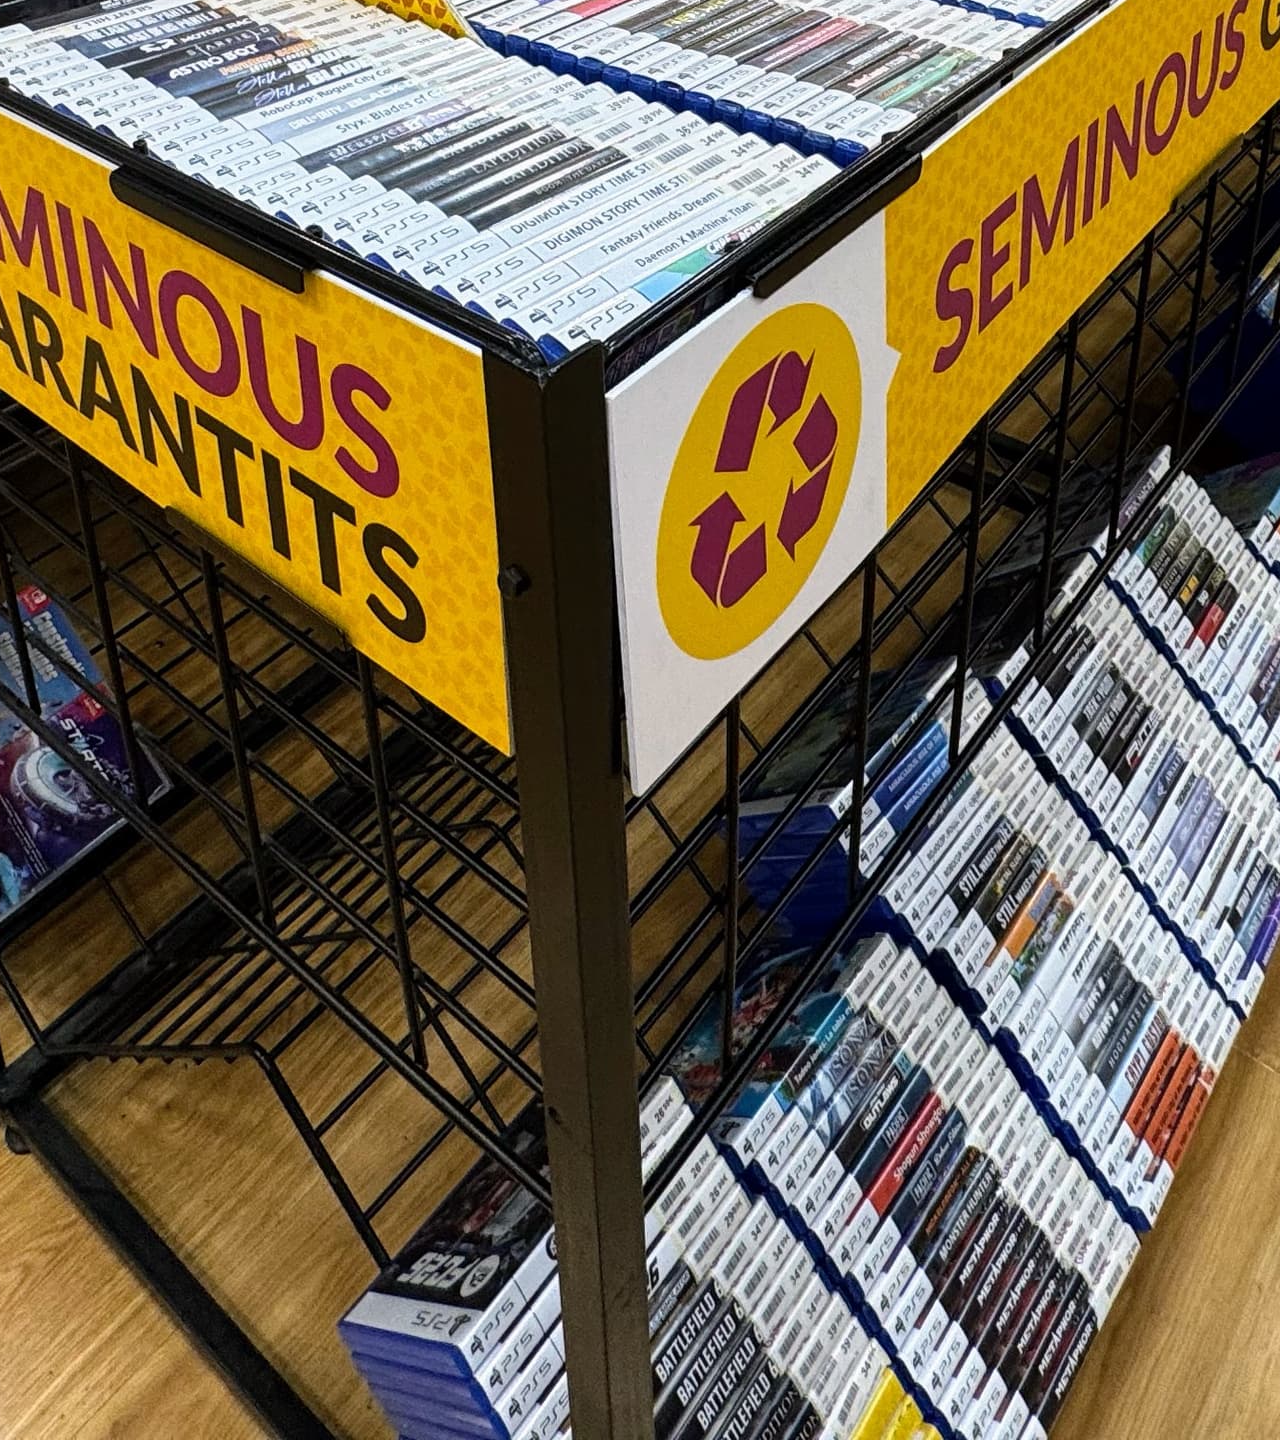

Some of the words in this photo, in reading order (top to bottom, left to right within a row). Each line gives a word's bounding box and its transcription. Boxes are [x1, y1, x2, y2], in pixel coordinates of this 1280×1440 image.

[509, 197, 568, 235] DIGIMON
[568, 177, 607, 212] STORY
[607, 163, 636, 190] TIME
[544, 214, 602, 251] DIGIMON
[601, 195, 642, 228] STORY
[642, 181, 669, 206] TIME
[600, 225, 644, 257] Fantasy
[642, 209, 684, 236] Friends:
[684, 189, 718, 213] Dream
[959, 858, 984, 898] STILL
[654, 1295, 717, 1385] BATTLEFIELD
[696, 1340, 757, 1432] BATTLEFIELD
